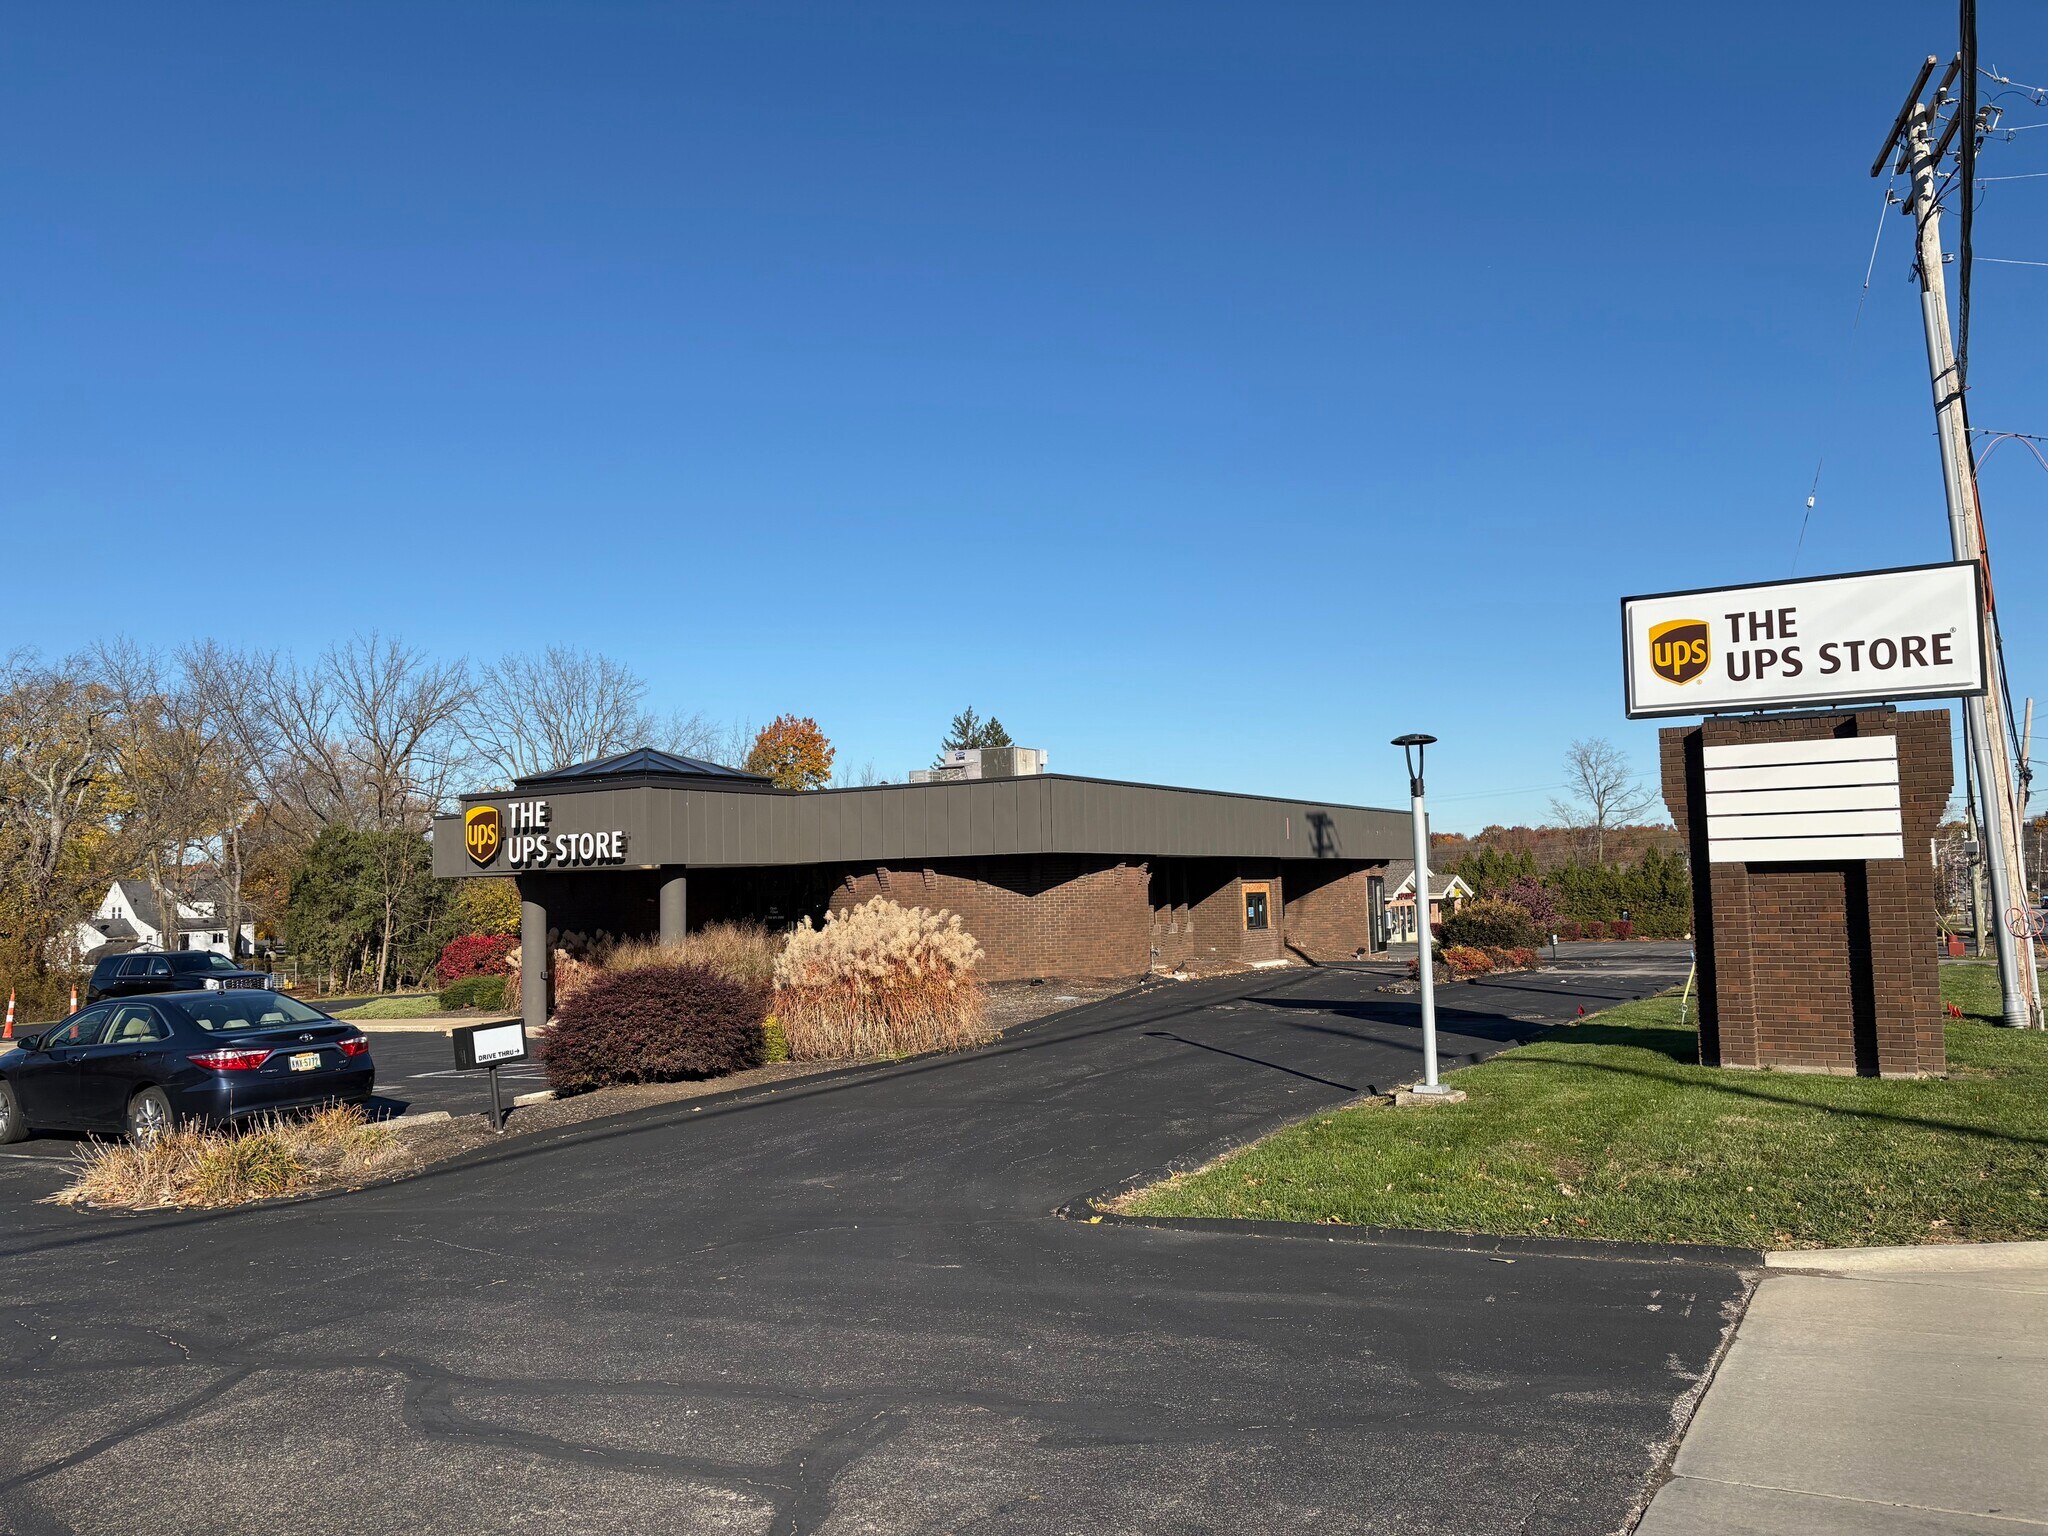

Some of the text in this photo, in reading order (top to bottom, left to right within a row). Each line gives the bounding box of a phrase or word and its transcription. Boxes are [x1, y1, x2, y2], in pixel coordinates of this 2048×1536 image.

[1725, 607, 1798, 643] THE
[1654, 638, 1707, 676] ups
[1726, 632, 1953, 682] UPS STORE
[508, 801, 546, 829] THE
[467, 823, 496, 854] ups
[508, 830, 623, 863] UPS STORE
[478, 1049, 514, 1062] DRIVE THRU
